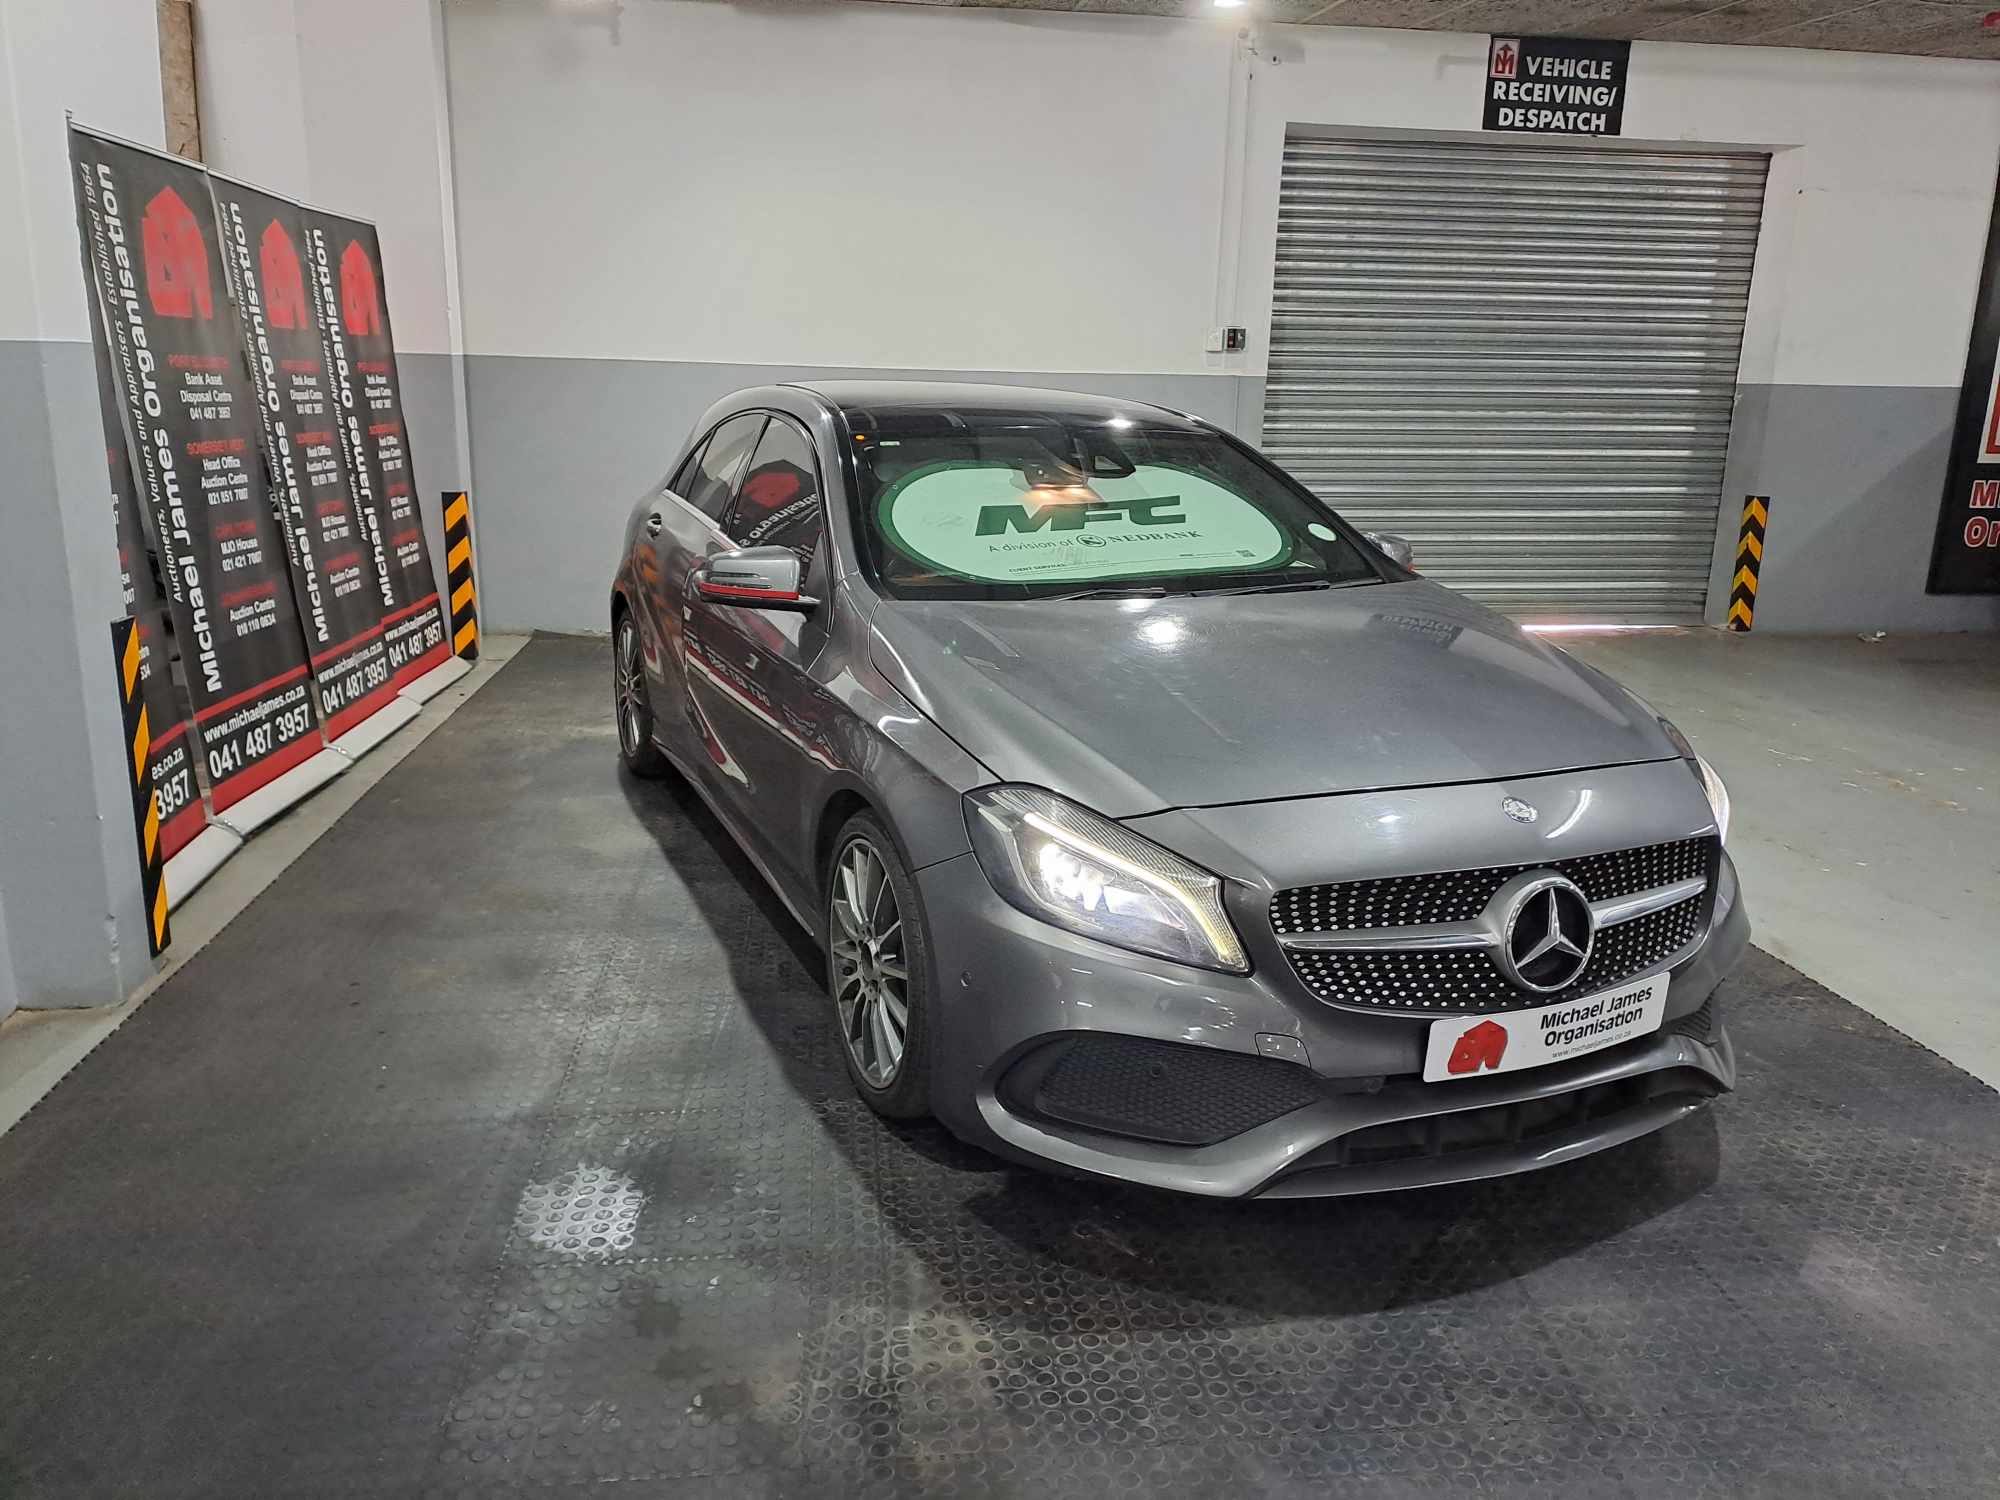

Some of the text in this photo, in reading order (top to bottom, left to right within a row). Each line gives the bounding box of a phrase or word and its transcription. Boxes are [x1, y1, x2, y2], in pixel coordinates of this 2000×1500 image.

[1493, 81, 1618, 107] RECEIVING/
[1526, 56, 1613, 80] VEHICLE
[1498, 107, 1607, 132] DESPATCH
[89, 208, 118, 305] Established
[230, 203, 280, 412] Organisation
[313, 229, 353, 408] Organisation
[115, 320, 140, 406] Appraisers
[132, 409, 147, 440] and
[180, 390, 212, 405] Disposal
[97, 163, 222, 692] Michael James Organisation
[275, 422, 304, 519] James
[348, 416, 372, 500] James
[1969, 480, 2000, 508] M
[364, 507, 394, 606] Michael
[989, 530, 1202, 552] A division of NEDBANK
[295, 527, 329, 642] Michael
[388, 621, 442, 667] 041 487 3957
[204, 685, 306, 743] www.michaeljames.co.za
[322, 657, 388, 714] 041 487 3957
[209, 703, 311, 779] 041 487 3957
[155, 768, 190, 821] 3957
[1540, 987, 1653, 1030] Michael James
[1544, 1007, 1643, 1046] Organisation
